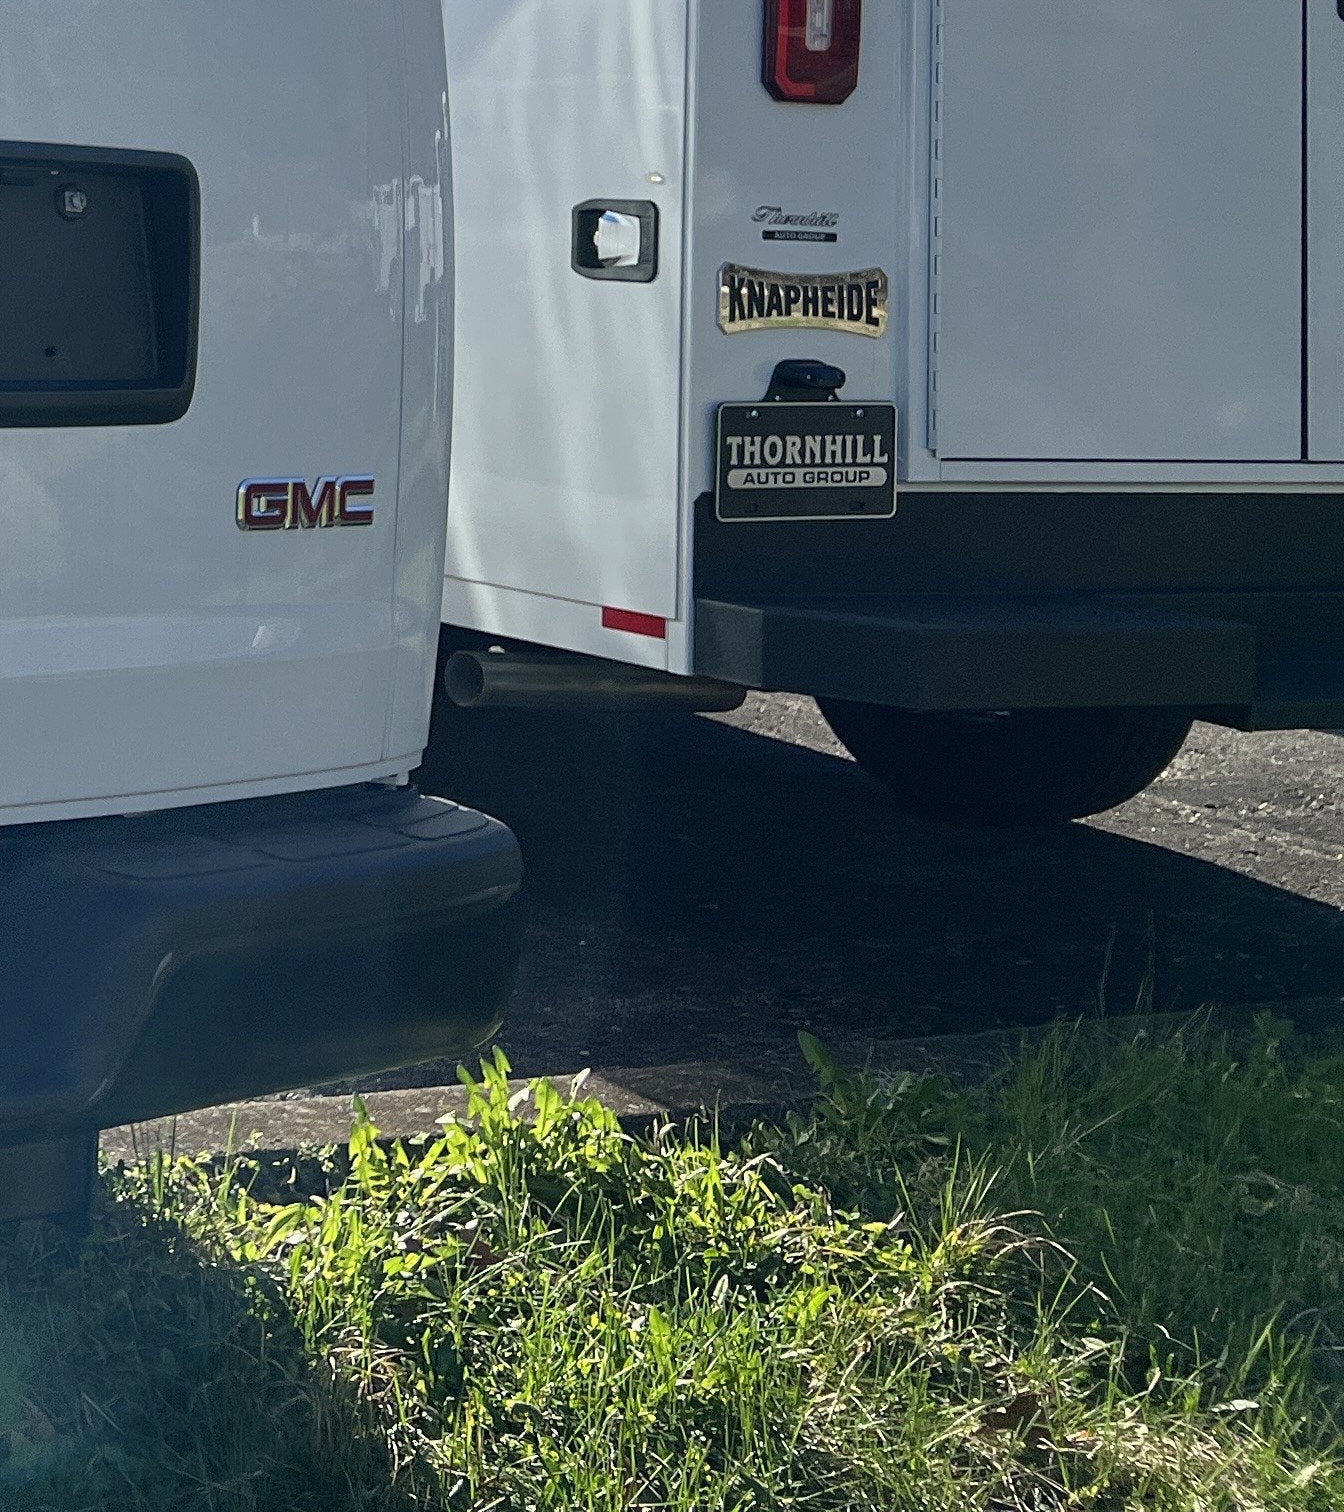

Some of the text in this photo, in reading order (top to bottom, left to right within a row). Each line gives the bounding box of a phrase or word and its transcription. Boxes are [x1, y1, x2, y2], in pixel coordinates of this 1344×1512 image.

[727, 274, 881, 327] KNAPHEIDE
[726, 434, 889, 466] THORNHILL
[743, 470, 870, 486] AUTO GROUP
[235, 472, 376, 531] GMC
